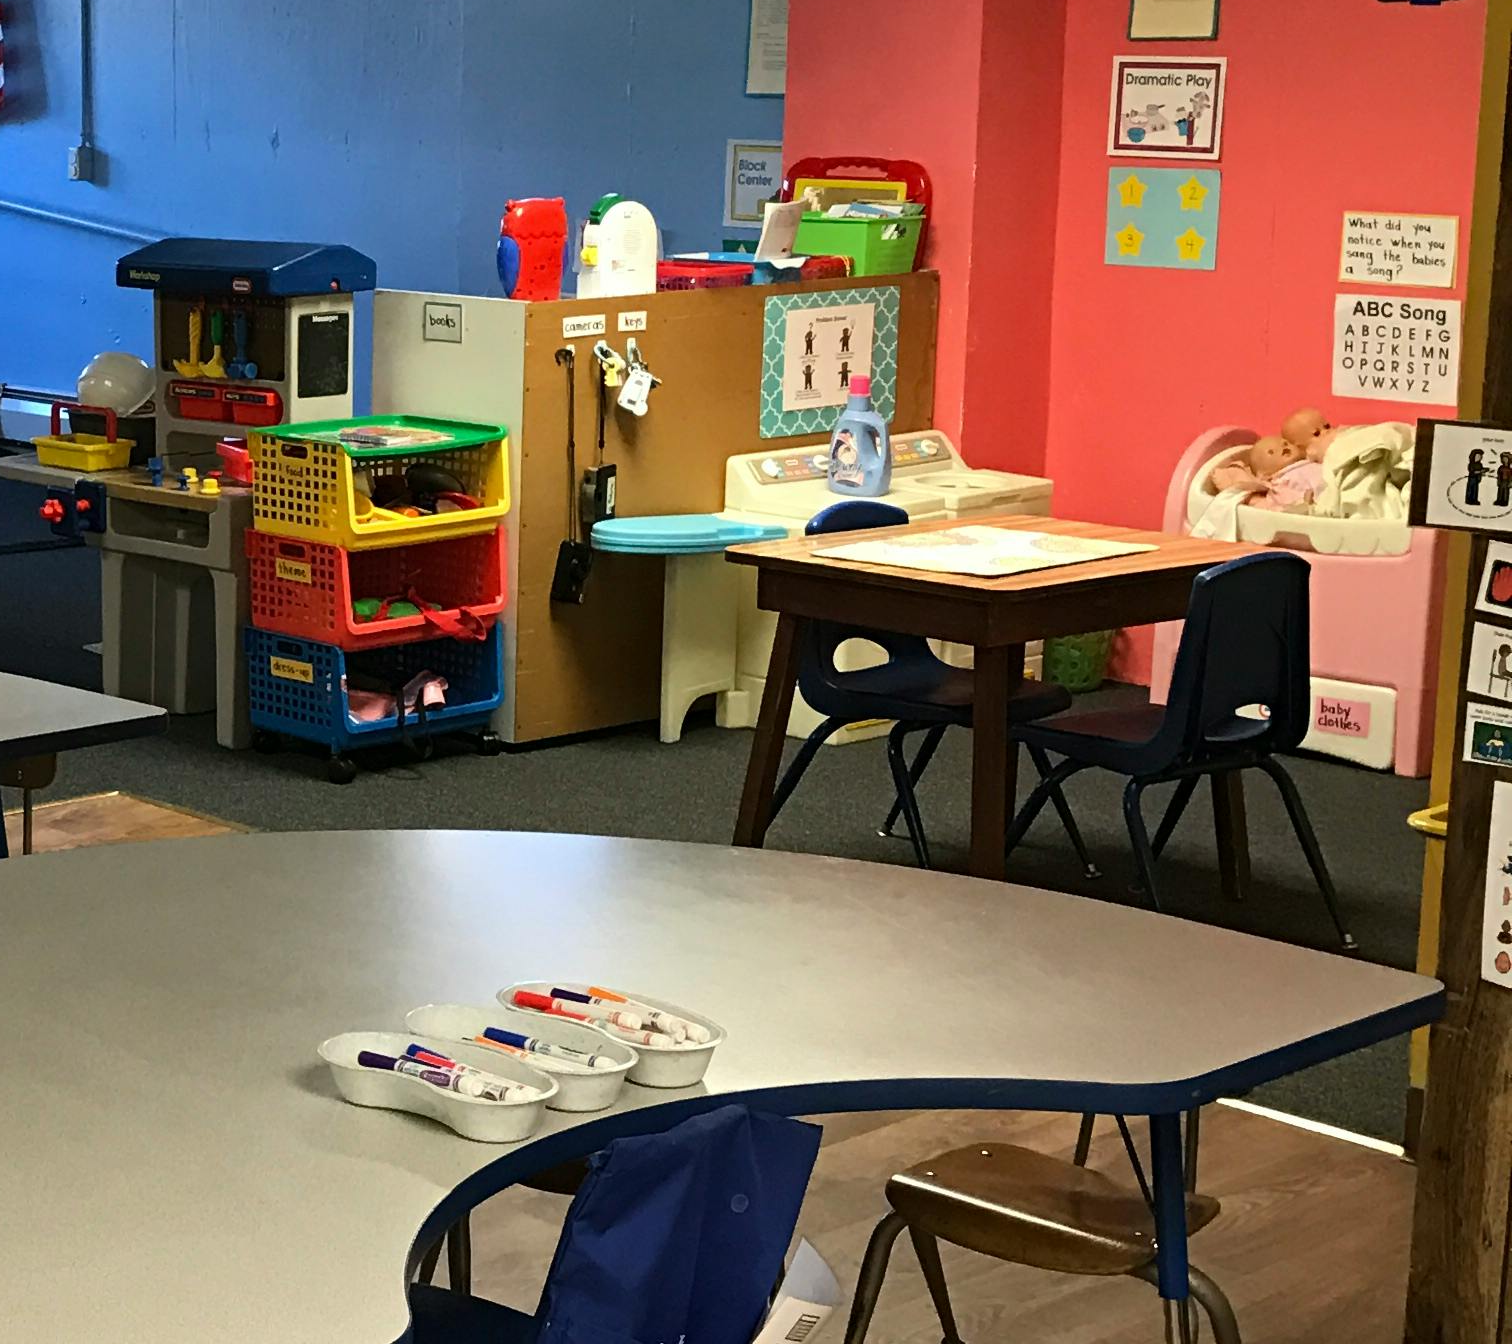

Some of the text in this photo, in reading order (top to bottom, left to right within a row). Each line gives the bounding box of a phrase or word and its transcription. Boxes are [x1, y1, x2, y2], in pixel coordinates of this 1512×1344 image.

[1125, 73, 1212, 89] Dramatic Play
[739, 159, 767, 172] Block
[738, 173, 772, 186] Center
[1189, 186, 1198, 201] 2
[1348, 218, 1431, 235] What did you
[1124, 234, 1135, 248] 3
[1186, 238, 1195, 252] 4
[1347, 234, 1446, 251] notice when you
[1346, 250, 1446, 267] sang the babies
[129, 269, 160, 282] Workshop
[1345, 265, 1403, 281] a song?
[429, 313, 456, 329] books
[1353, 301, 1447, 326] ABC Song
[565, 319, 604, 333] cameras
[624, 315, 643, 329] keys
[1345, 324, 1450, 342] A B C D E F G
[1345, 341, 1448, 359] H I J K L M N
[1343, 357, 1447, 376] O P Q R S T U
[1358, 376, 1429, 392] V W X Y Z
[277, 563, 307, 579] theme
[272, 660, 310, 678] dress-up
[1321, 698, 1351, 719] baby
[1317, 715, 1361, 732] clothes
